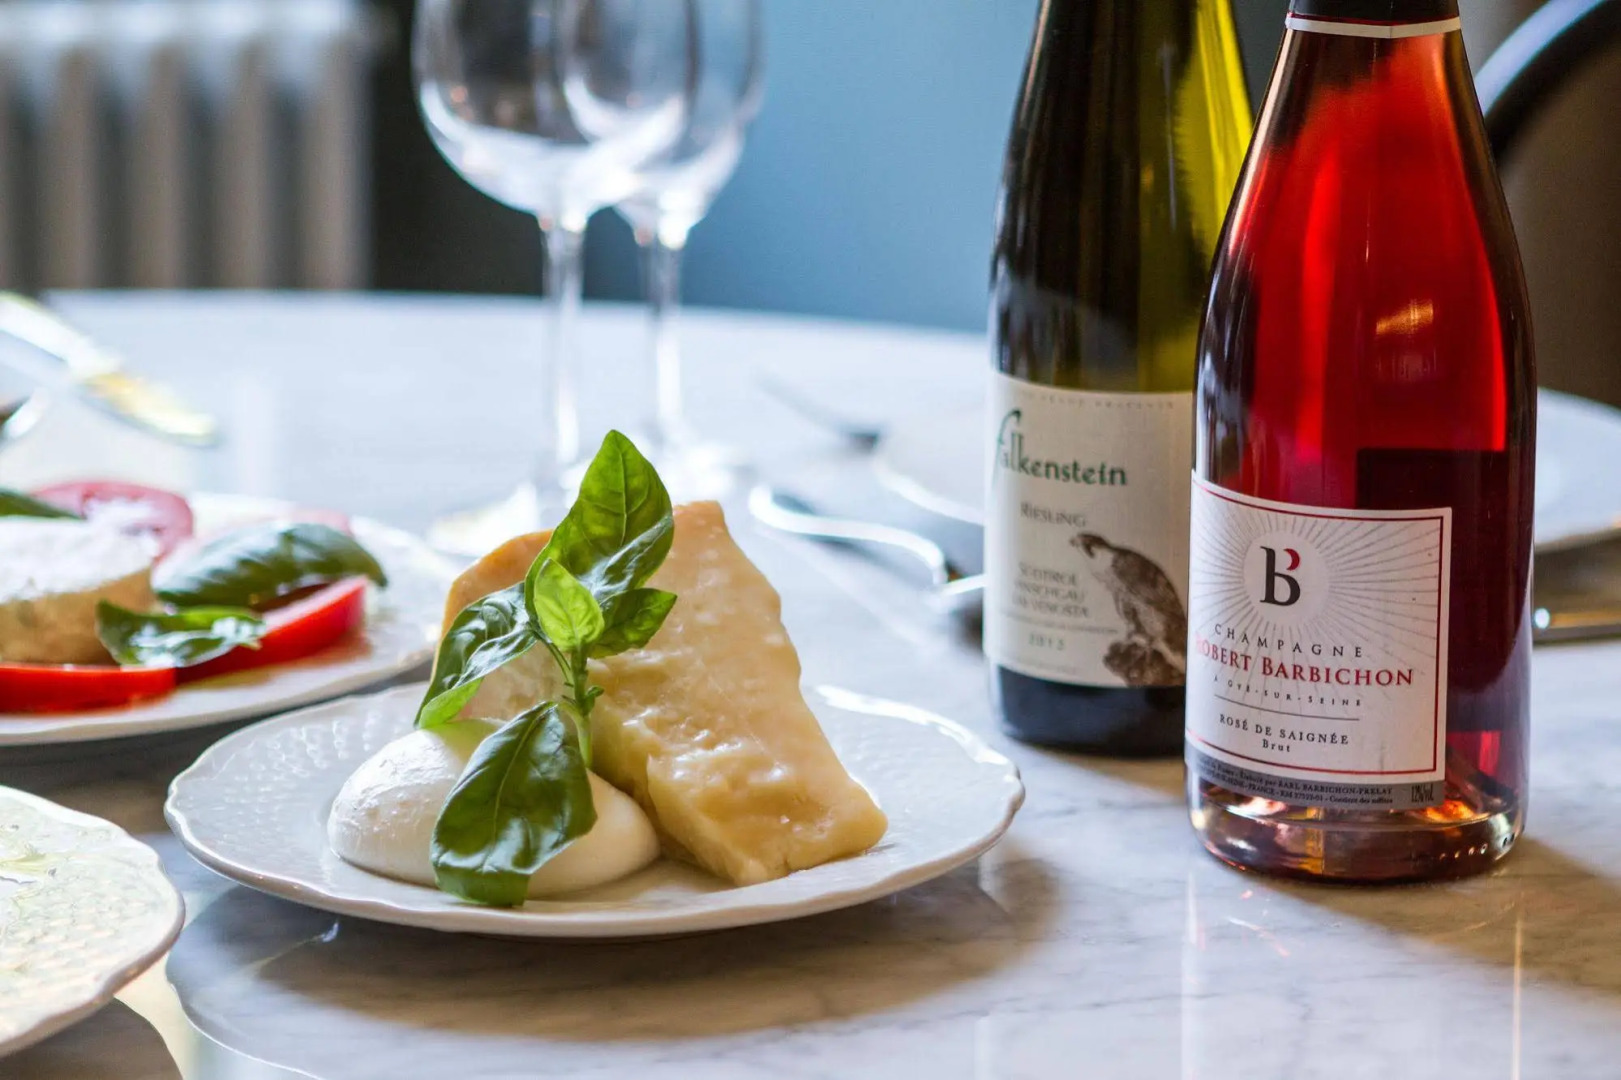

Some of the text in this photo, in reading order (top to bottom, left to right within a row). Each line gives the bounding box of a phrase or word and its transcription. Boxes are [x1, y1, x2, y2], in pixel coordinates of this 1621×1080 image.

[1214, 624, 1363, 657] CHAMPAGNE
[1262, 656, 1413, 686] BARBICHON
[1219, 714, 1349, 745] ROSÉ DE SAIGNÉE
[1262, 738, 1291, 753] Brut
